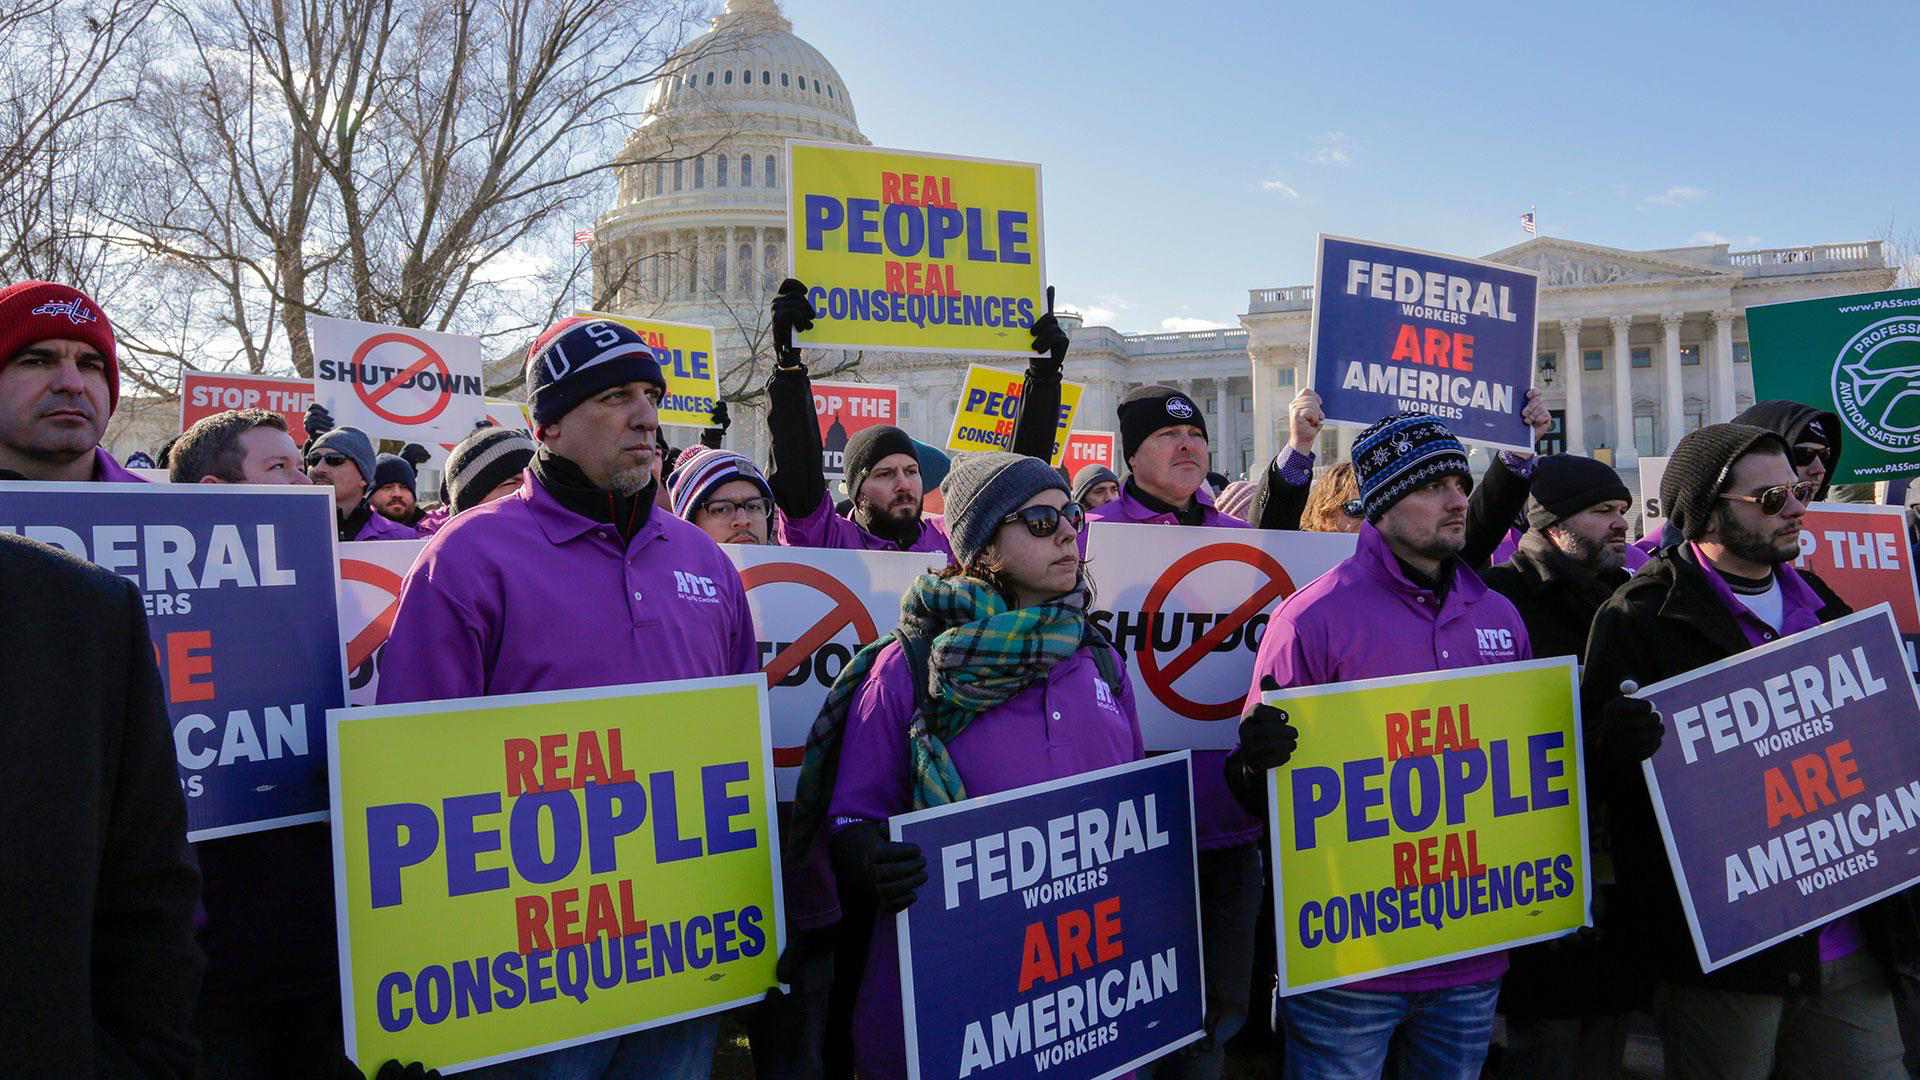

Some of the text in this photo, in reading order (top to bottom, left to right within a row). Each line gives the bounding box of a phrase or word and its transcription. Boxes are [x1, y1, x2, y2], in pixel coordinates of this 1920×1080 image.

[882, 171, 960, 210] REAL
[805, 194, 1031, 264] PEOPLE
[885, 261, 961, 298] REAL
[1346, 259, 1516, 322] FEDERAL
[808, 285, 1035, 329] CONSEQUENCES
[1402, 303, 1467, 325] WORKERS
[652, 348, 710, 380] PLE
[1391, 324, 1474, 372] ARE
[191, 385, 314, 413] STOP THE
[319, 359, 482, 396] SHUTDOWN
[1342, 360, 1513, 414] AMERICAN
[813, 394, 891, 418] OP THE
[1397, 399, 1463, 420] WORKERS
[1840, 381, 1910, 445] AVIATION SAFETY
[1071, 442, 1107, 461] THE
[1824, 531, 1900, 569] THE
[673, 570, 717, 597] ATC
[1089, 609, 1273, 653] SHUTDO
[1475, 628, 1513, 650] ATC
[1672, 646, 1887, 764] FEDERAL
[1385, 704, 1480, 762] REAL
[1753, 714, 1834, 758] WORKERS
[504, 728, 635, 797] REAL
[1763, 739, 1865, 829] ARE
[1291, 731, 1570, 851] PEOPLE
[366, 761, 757, 909] PEOPLE
[941, 793, 1169, 910] FEDERAL
[1725, 780, 1920, 903] AMERICAN
[1393, 830, 1487, 891] REAL
[1796, 850, 1878, 896] WORKERS
[1023, 866, 1108, 909] WORKERS
[1299, 854, 1574, 949] CONSEQUENCES
[515, 879, 648, 955] REAL
[377, 905, 766, 1033] CONSEQUENCES
[1018, 896, 1125, 992] ARE
[959, 947, 1178, 1079] AMERICAN
[1034, 1022, 1118, 1072] WORKERS
